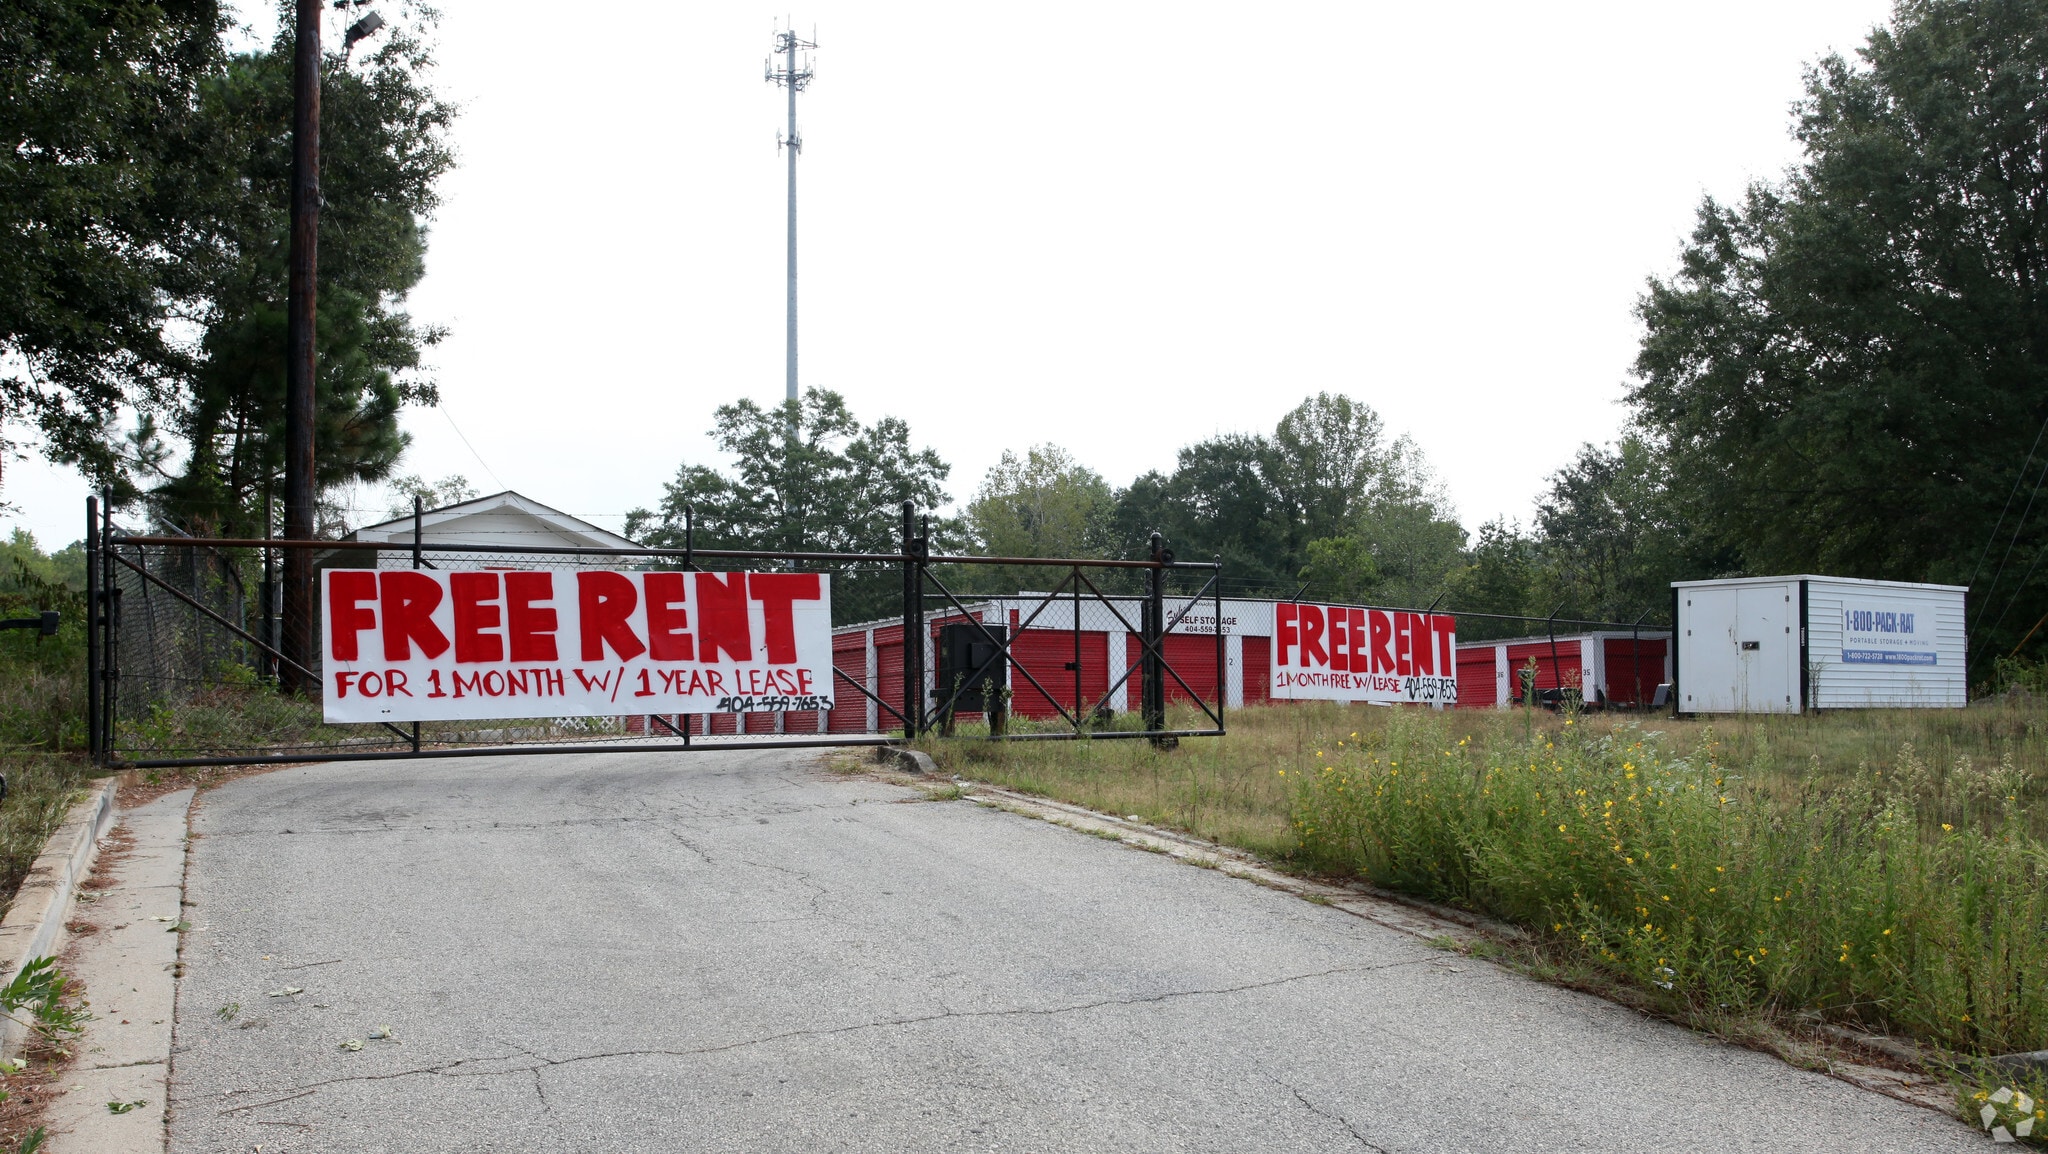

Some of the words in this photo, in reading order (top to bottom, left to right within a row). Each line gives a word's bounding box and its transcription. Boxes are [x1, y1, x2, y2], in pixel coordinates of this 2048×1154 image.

[329, 571, 558, 663] FREE
[577, 571, 821, 665] RENT
[1180, 616, 1199, 624] SELF
[1200, 616, 1238, 625] STOAGE
[1185, 625, 1231, 633] 404-559-753
[1849, 637, 1878, 645] PORTABLE
[1879, 638, 1903, 646] STORAGE
[1228, 657, 1234, 666] 2
[1583, 668, 1591, 676] 35
[335, 669, 414, 699] FOR
[427, 669, 448, 698] 1
[452, 667, 565, 698] MONTH
[572, 666, 625, 703] W/
[657, 668, 730, 697] YEAR
[735, 668, 813, 697] LEASE
[1353, 675, 1373, 693] W/
[1373, 677, 1402, 694] LEASE
[1404, 676, 1457, 700] 404-559-7653
[717, 695, 834, 713] 404-559-7653
